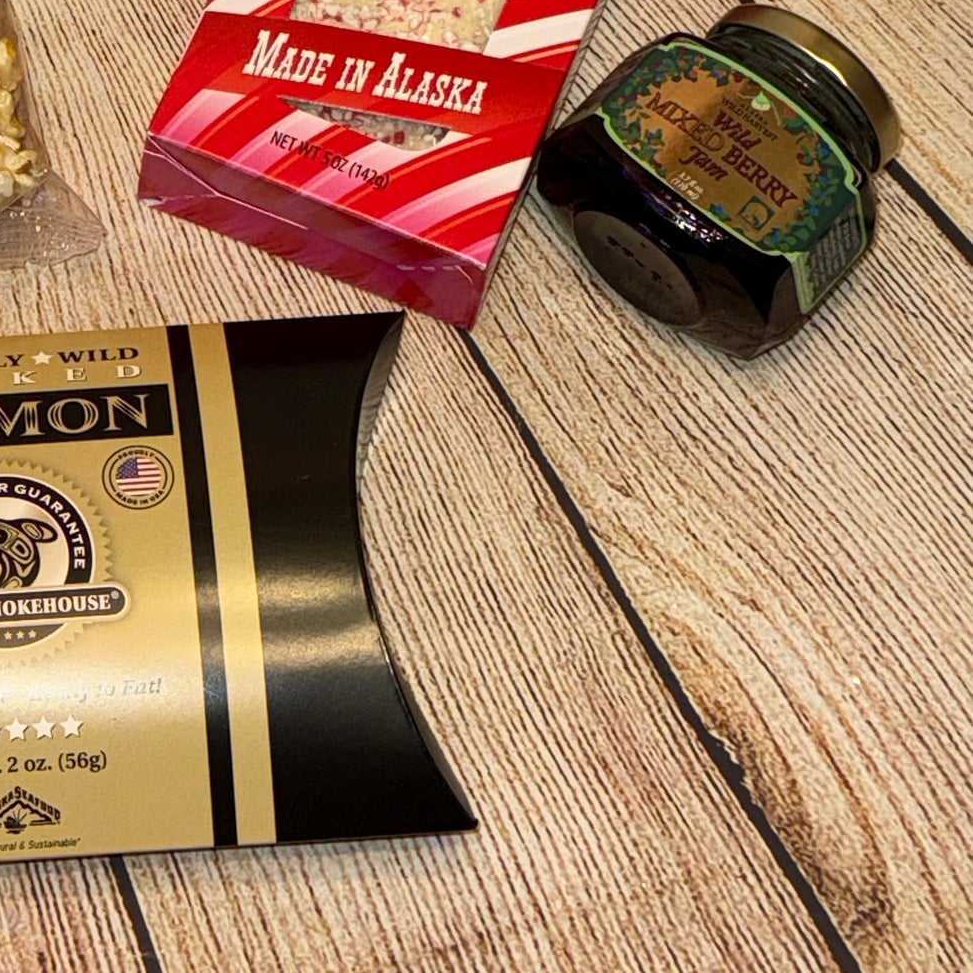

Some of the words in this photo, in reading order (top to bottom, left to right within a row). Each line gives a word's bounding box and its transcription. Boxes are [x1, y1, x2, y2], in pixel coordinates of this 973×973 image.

[242, 29, 336, 86] MADE
[372, 51, 488, 115] ALASKA
[270, 131, 297, 152] NET
[298, 140, 322, 161] WT
[713, 109, 762, 150] Wild
[645, 92, 725, 152] MIXED
[721, 144, 798, 207] BERRY
[679, 145, 728, 181] Jam
[57, 346, 139, 364] WILD
[116, 492, 138, 505] MADE
[14, 484, 85, 570] GUARANTEE
[7, 756, 19, 773] 2
[24, 759, 52, 772] oz.
[58, 751, 108, 774] (56g)
